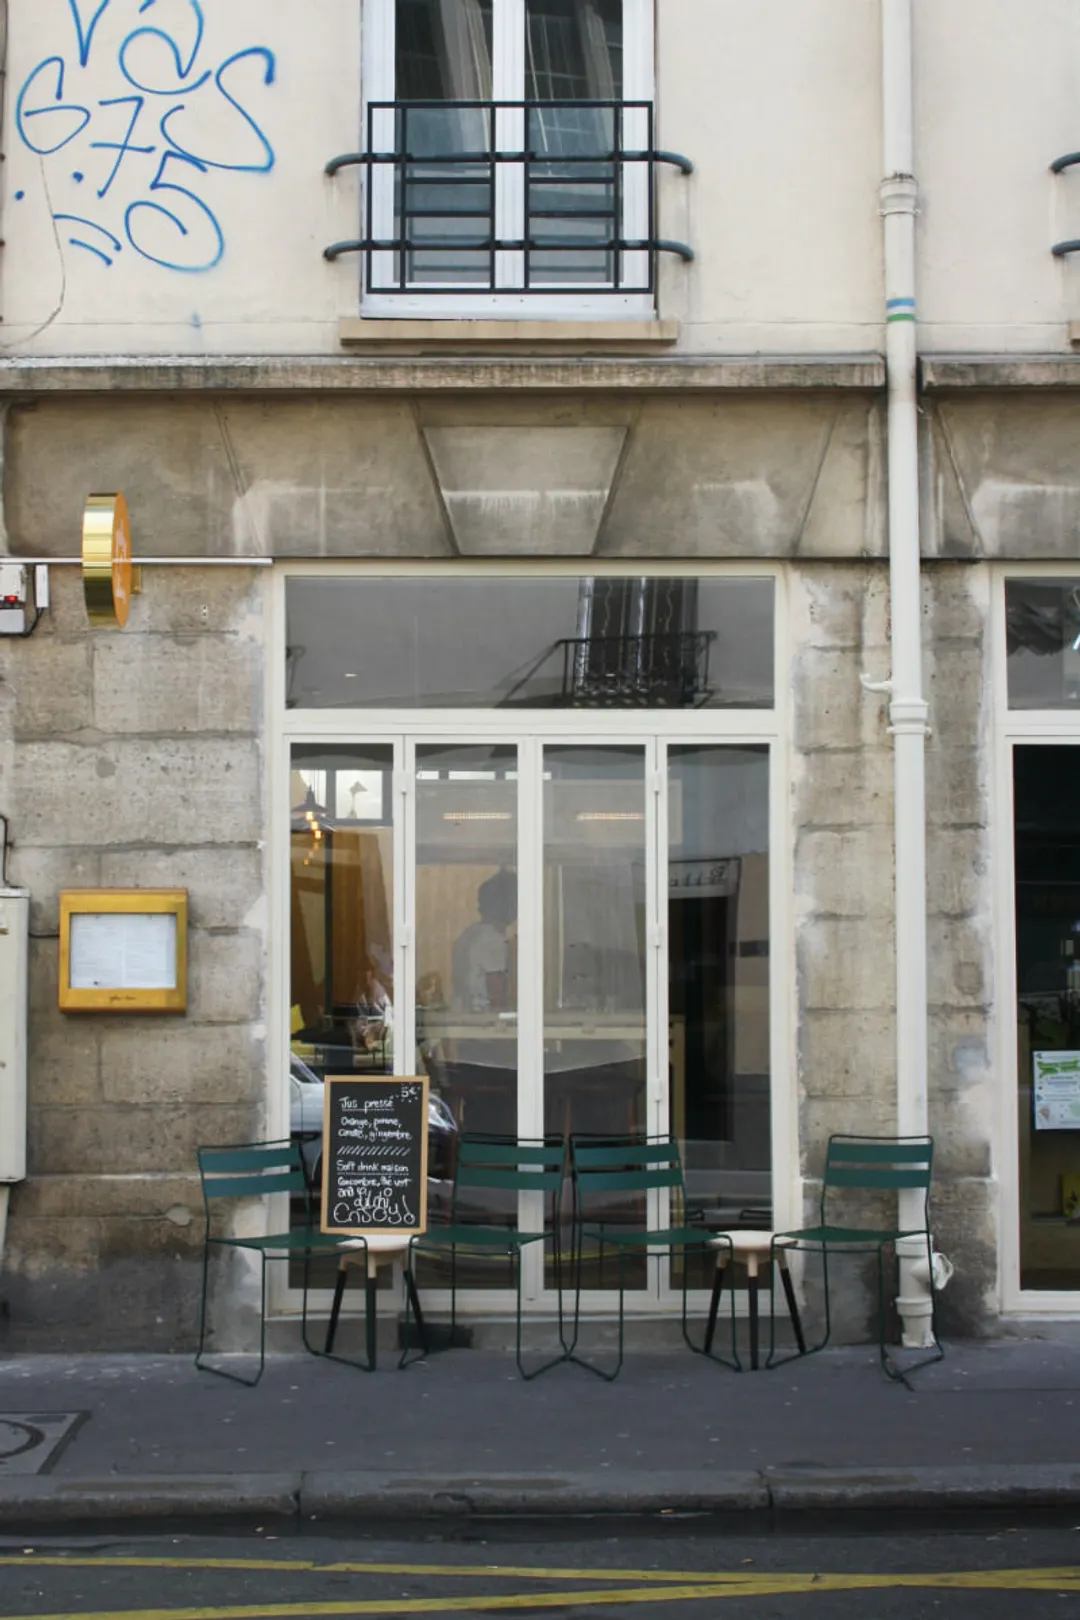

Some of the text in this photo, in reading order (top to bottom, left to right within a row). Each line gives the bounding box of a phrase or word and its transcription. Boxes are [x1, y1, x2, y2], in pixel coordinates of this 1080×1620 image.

[339, 1095, 394, 1114] Jus pressé
[336, 1159, 356, 1171] Soft
[357, 1161, 379, 1171] drink
